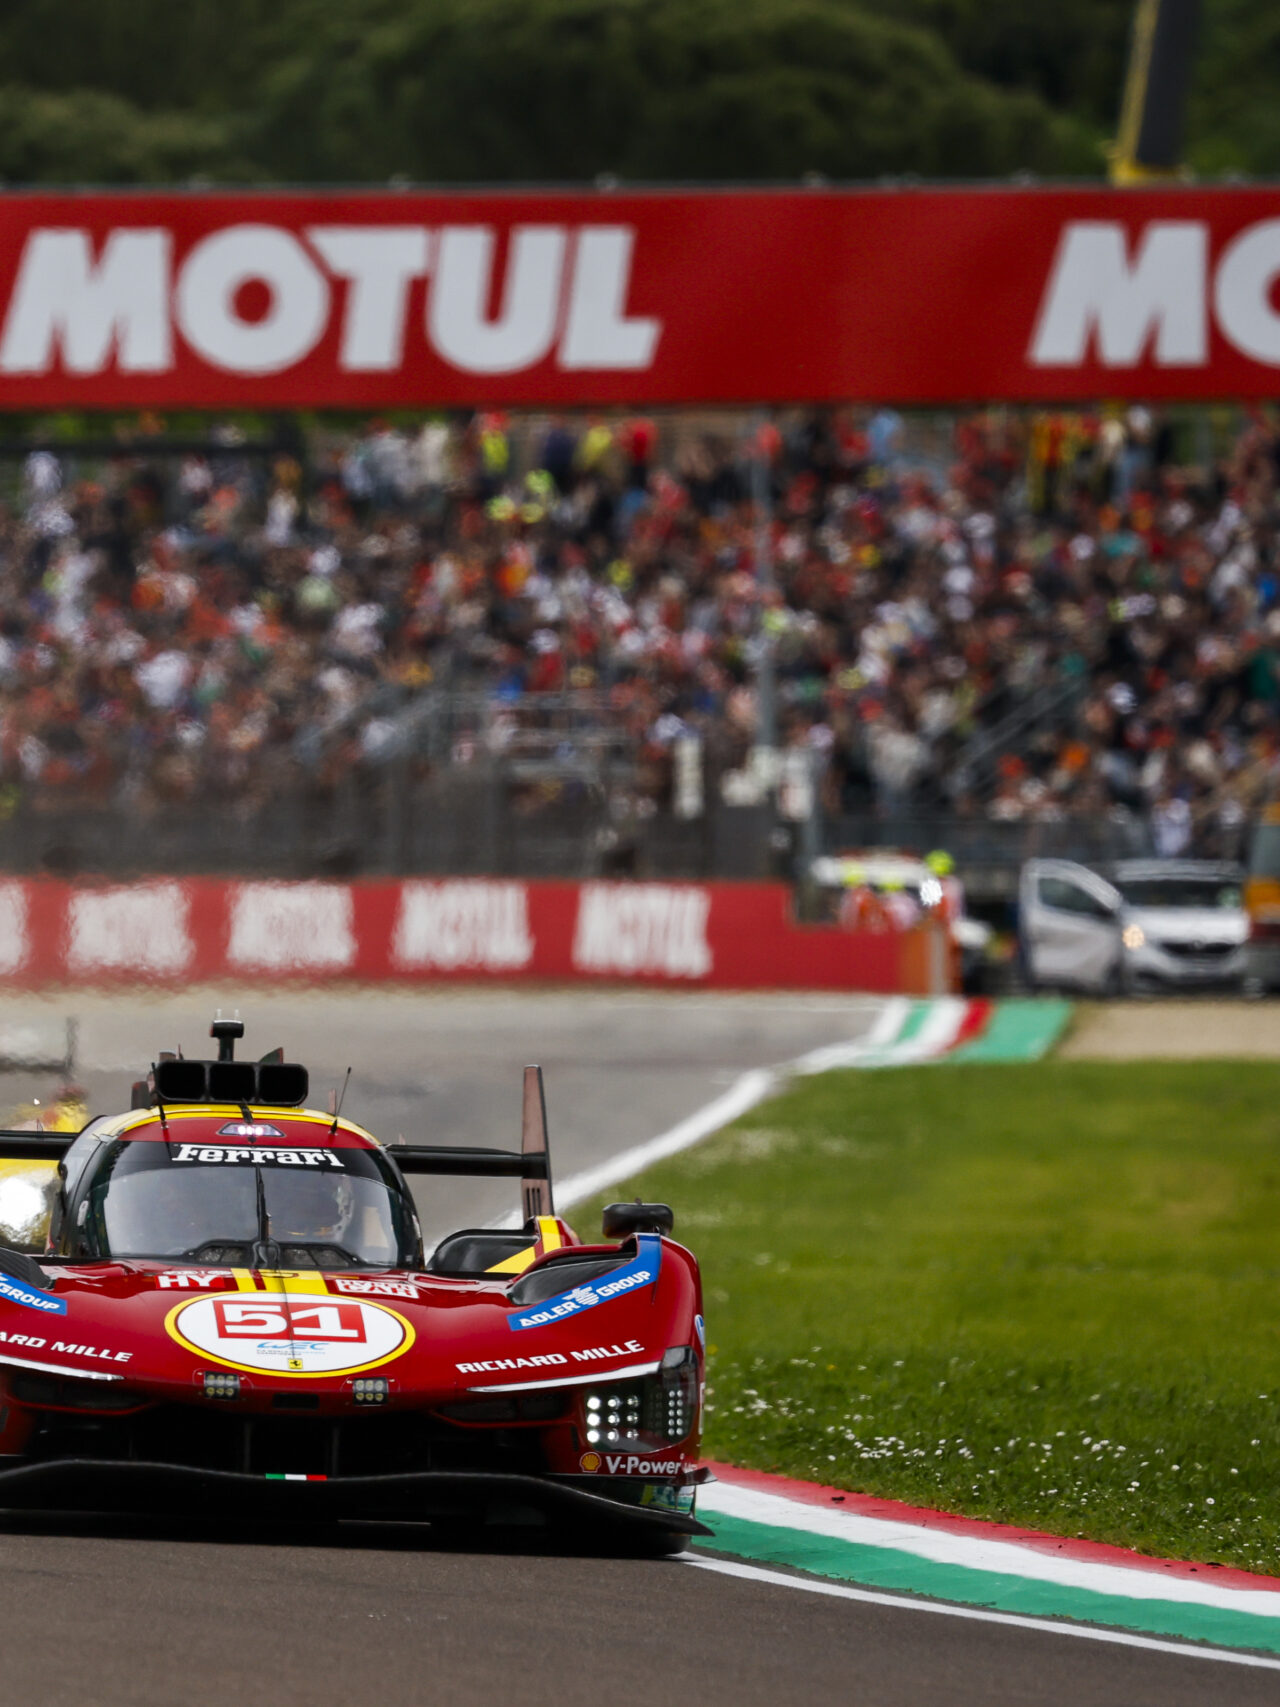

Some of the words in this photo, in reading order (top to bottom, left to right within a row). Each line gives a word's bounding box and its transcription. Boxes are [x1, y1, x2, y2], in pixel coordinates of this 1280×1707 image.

[172, 1144, 345, 1167] Ferrari
[158, 1275, 216, 1288] HY
[519, 1301, 580, 1327] ADLER
[596, 1270, 651, 1297] GROUP
[222, 1303, 359, 1337] 51
[51, 1341, 133, 1362] MILLE
[455, 1353, 568, 1374] RICHARD
[570, 1339, 645, 1362] MILLE
[605, 1455, 682, 1474] V-Power
